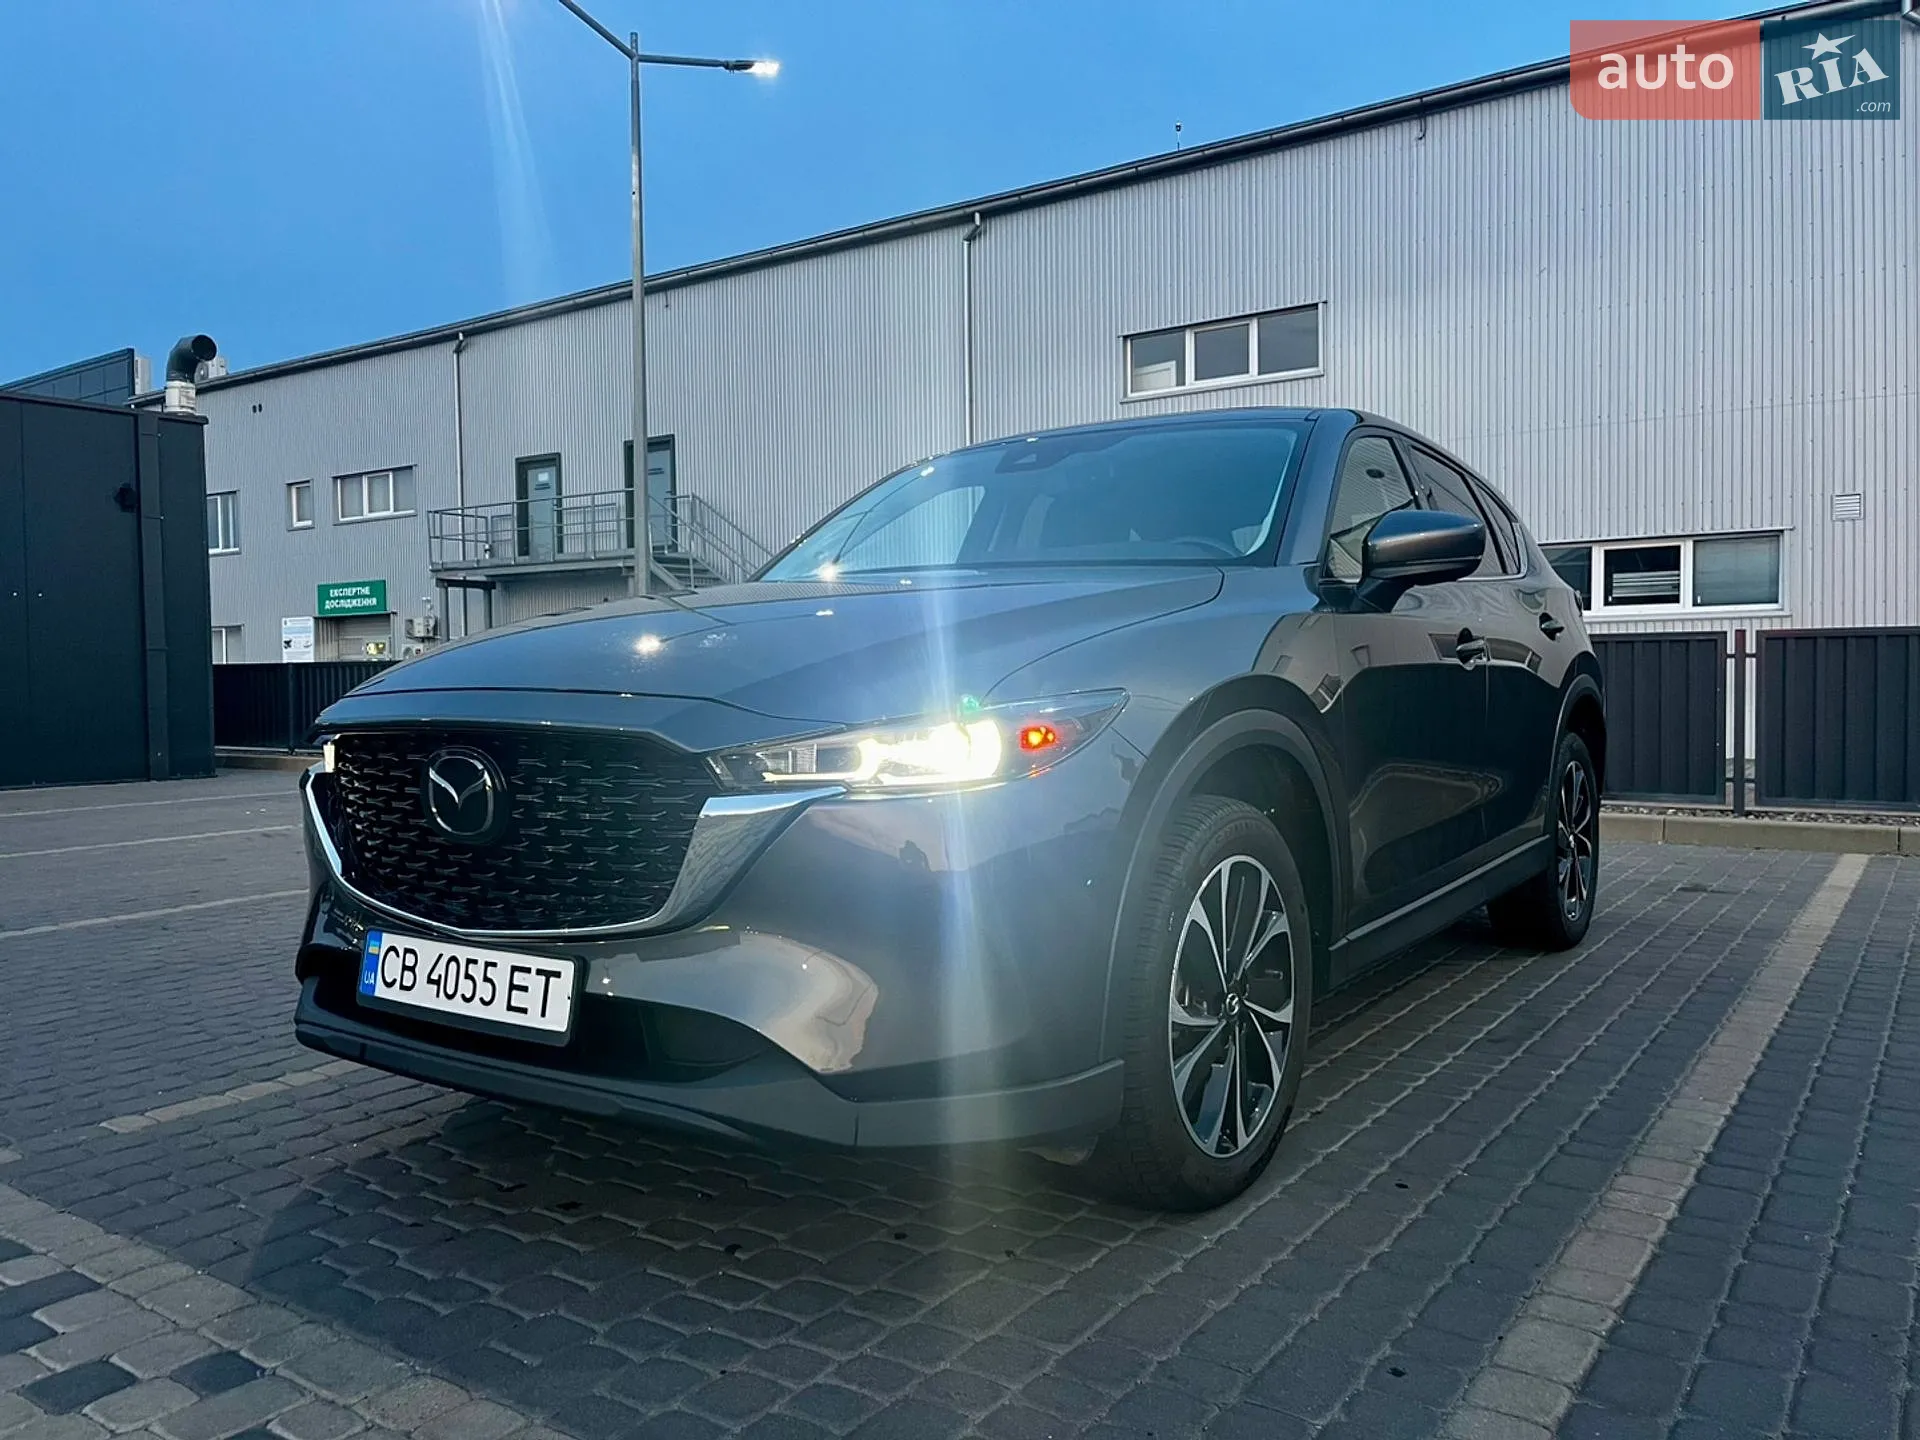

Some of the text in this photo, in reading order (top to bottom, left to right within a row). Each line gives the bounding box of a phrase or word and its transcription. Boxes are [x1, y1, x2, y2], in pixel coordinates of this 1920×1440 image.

[329, 586, 371, 597] ЕКСПЕРТНЕ
[324, 597, 378, 610] ДОСЛІДЖЕННЯ
[364, 969, 375, 985] UA
[381, 945, 562, 1018] CB 4055 ET
